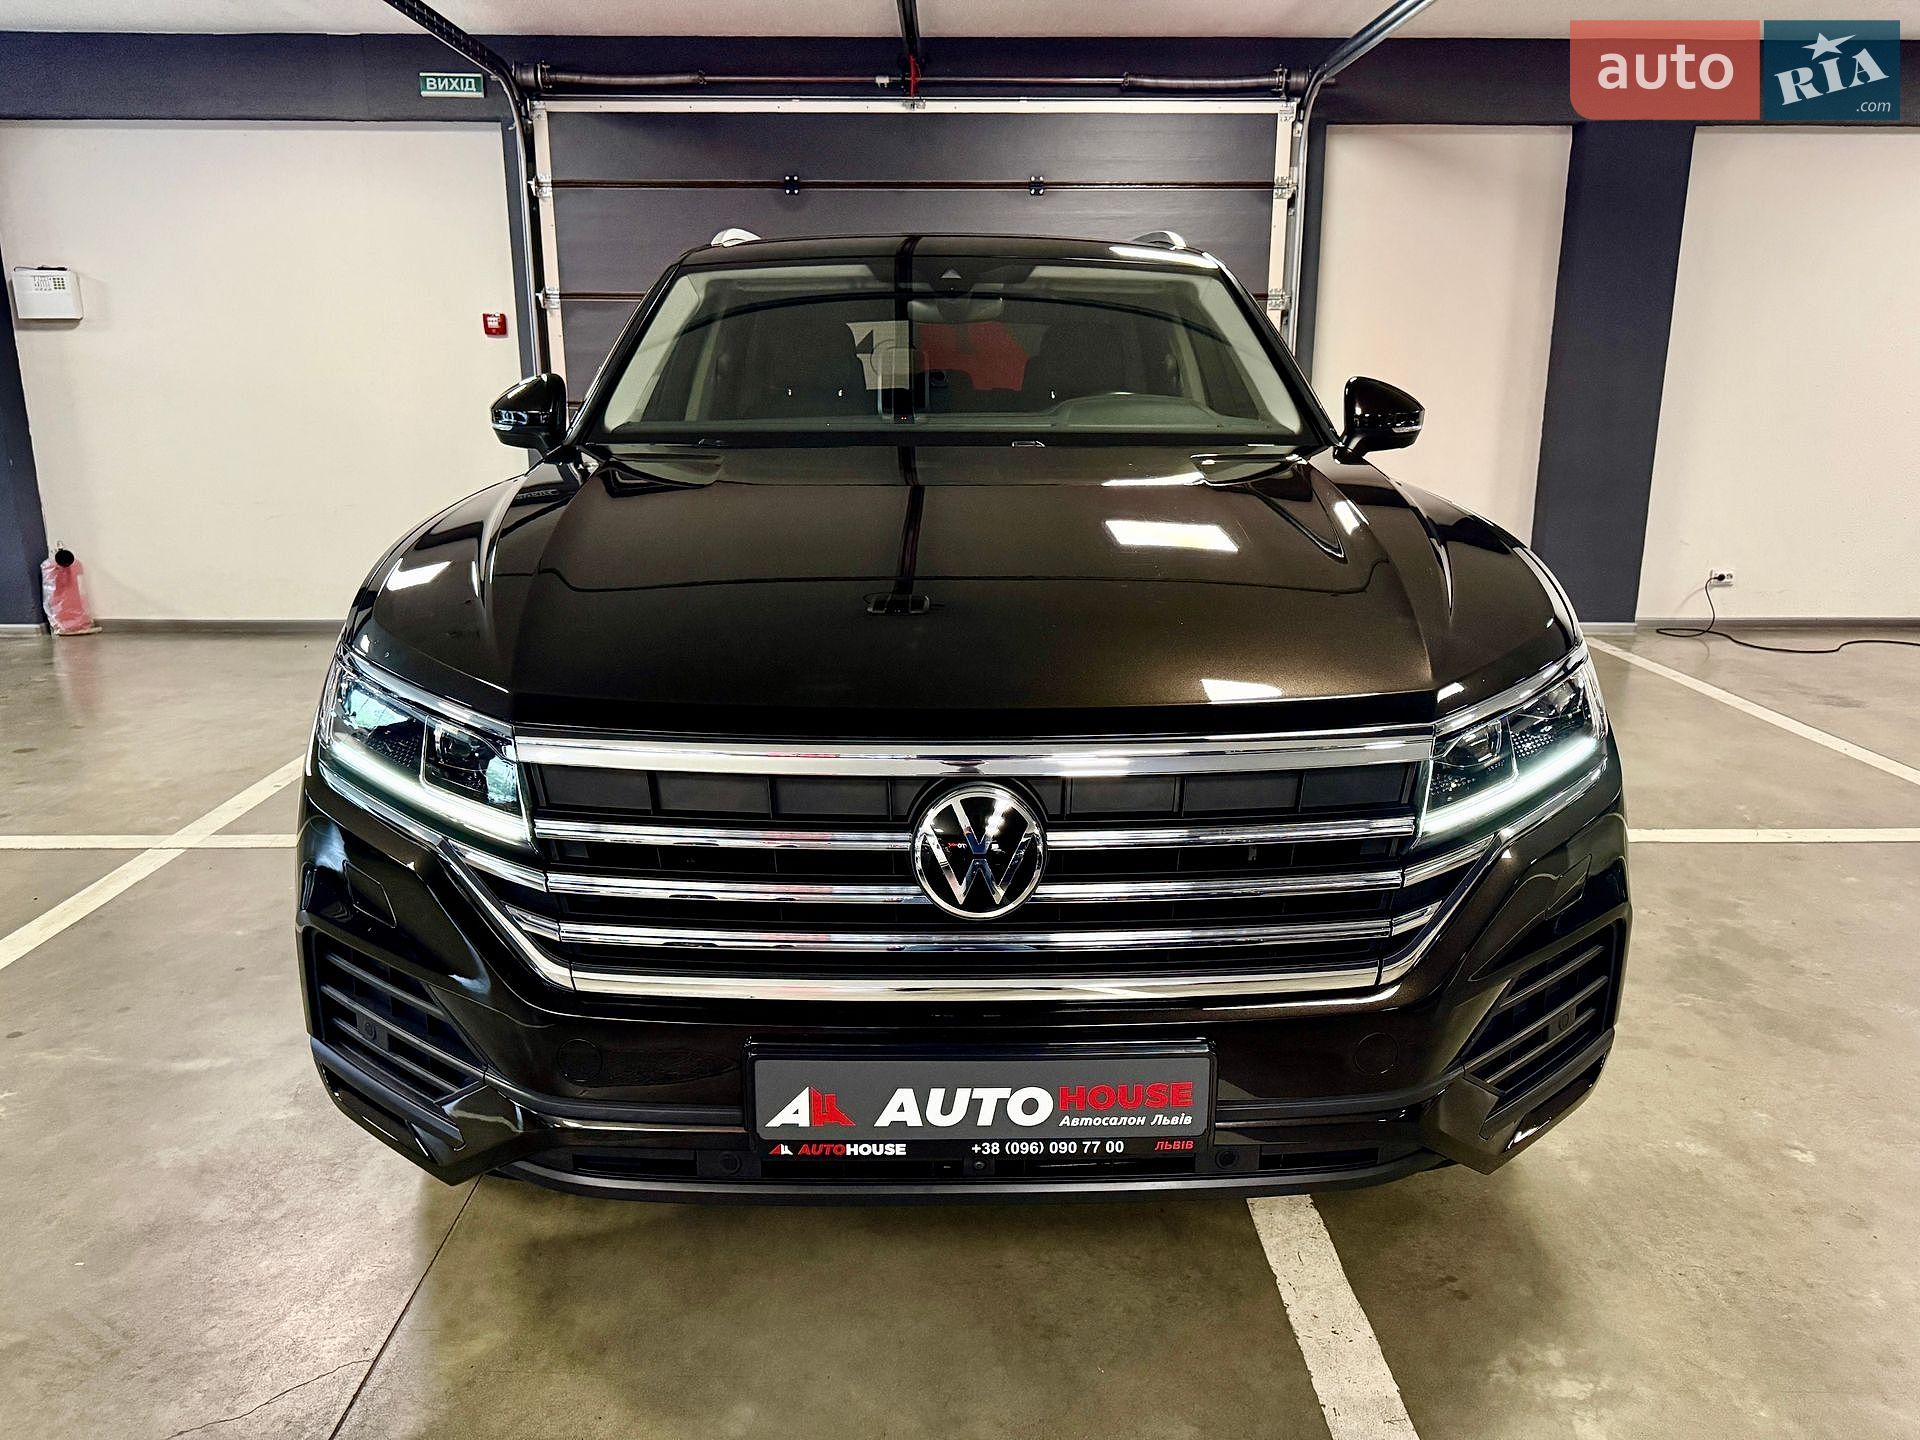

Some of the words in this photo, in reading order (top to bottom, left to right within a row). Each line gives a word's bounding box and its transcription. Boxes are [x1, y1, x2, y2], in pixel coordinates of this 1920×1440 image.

[426, 77, 477, 92] ВИХІД
[1058, 1081, 1194, 1111] HOUSE
[873, 1086, 1054, 1127] AUTO
[1058, 1115, 1147, 1127] Автосалон
[1150, 1112, 1193, 1126] Львів
[971, 1143, 1000, 1155] +38
[1004, 1142, 1044, 1156] (096)
[1049, 1141, 1078, 1155] 090
[1082, 1141, 1101, 1154] 77
[1105, 1140, 1125, 1154] 00
[1155, 1140, 1194, 1151] ЛЬВІВ
